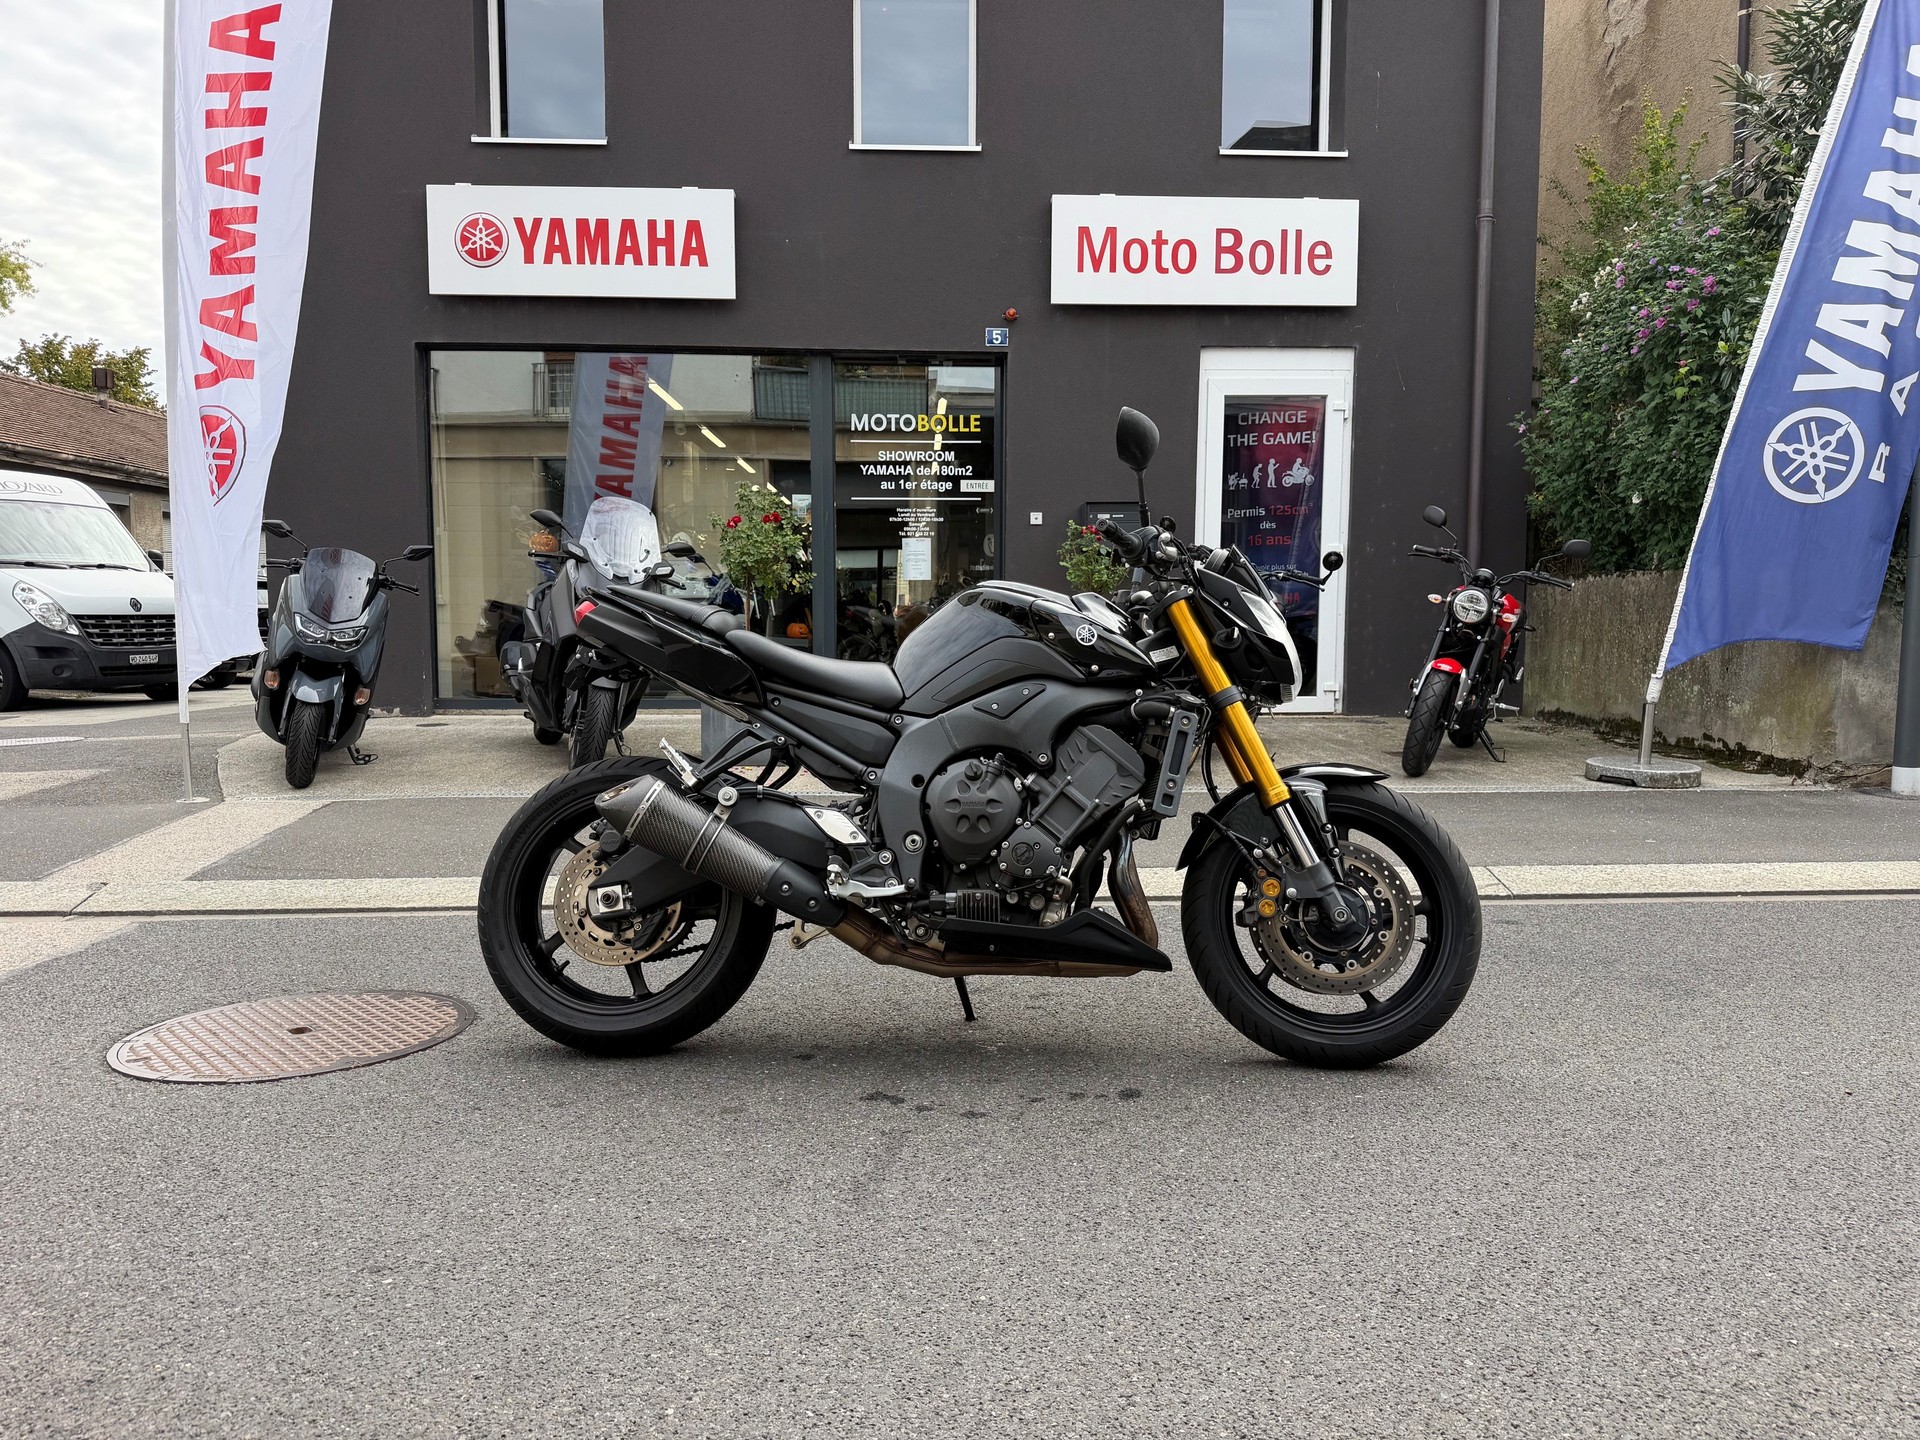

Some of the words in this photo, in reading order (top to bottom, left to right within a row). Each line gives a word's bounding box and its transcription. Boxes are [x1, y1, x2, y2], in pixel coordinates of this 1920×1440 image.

[193, 3, 282, 390] YAMAHA
[1793, 44, 1920, 392] YAMA
[512, 216, 709, 267] YAMAHA
[1076, 226, 1197, 274] Moto
[1214, 228, 1333, 275] Bolle
[992, 330, 1002, 344] 5
[850, 413, 981, 432] MOTOBOLLE
[1237, 410, 1308, 426] CHANGE
[1227, 433, 1259, 447] THE
[1262, 430, 1316, 446] GAME!
[878, 450, 955, 462] SHOWROOM
[860, 464, 914, 476] YAMAHA
[916, 465, 931, 476] de
[880, 481, 896, 490] au
[898, 479, 918, 490] 1er
[920, 479, 953, 492] étage
[966, 481, 989, 490] ENTRÉE
[1227, 505, 1266, 519] Permis
[1259, 521, 1277, 530] dès
[1248, 534, 1262, 546] 16
[1266, 535, 1292, 545] ans
[1271, 563, 1285, 571] plus
